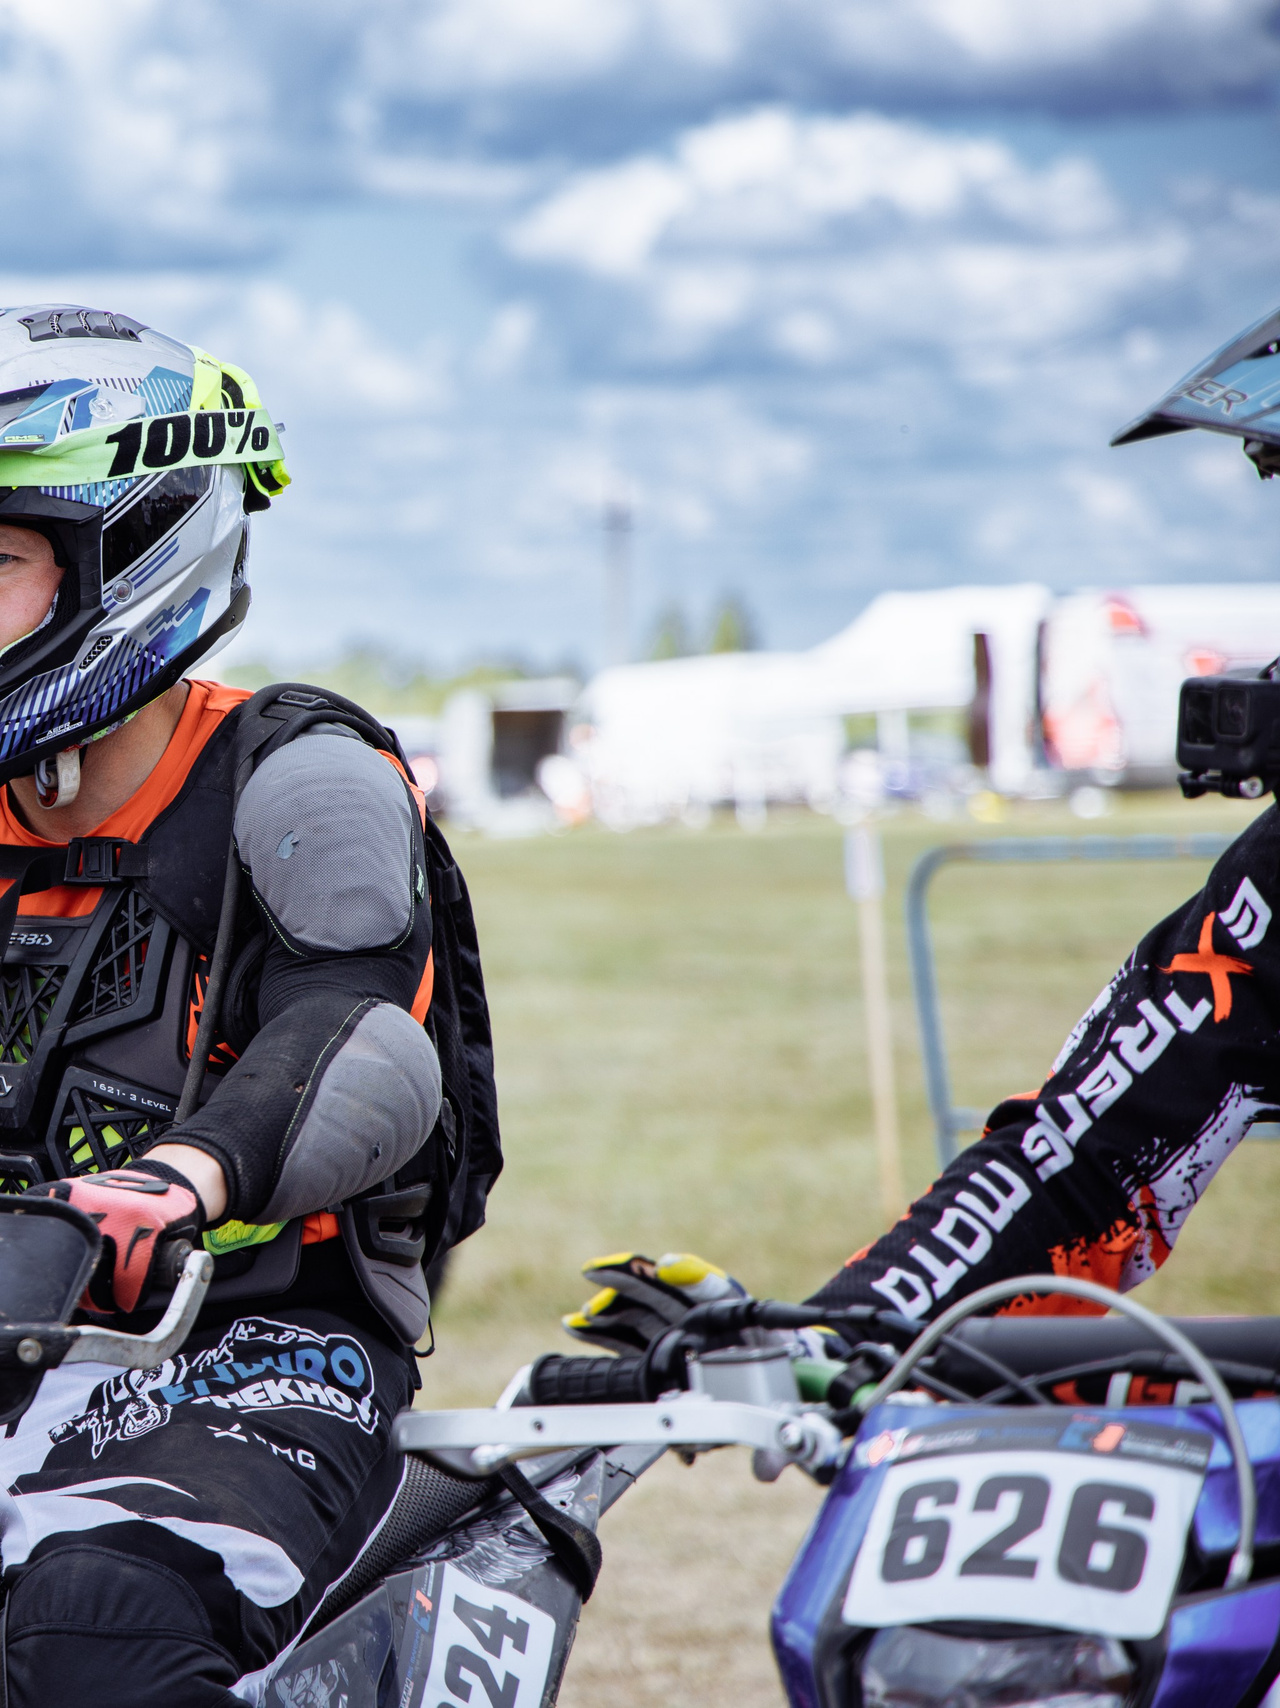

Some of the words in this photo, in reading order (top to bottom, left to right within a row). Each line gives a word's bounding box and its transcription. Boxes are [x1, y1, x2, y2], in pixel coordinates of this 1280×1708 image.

[105, 411, 269, 478] 100%
[8, 932, 53, 946] ERBIS
[141, 1098, 172, 1112] LEVEL
[871, 1160, 1032, 1320] MOTO
[880, 1473, 1156, 1593] 626
[443, 1593, 530, 1708] 24
